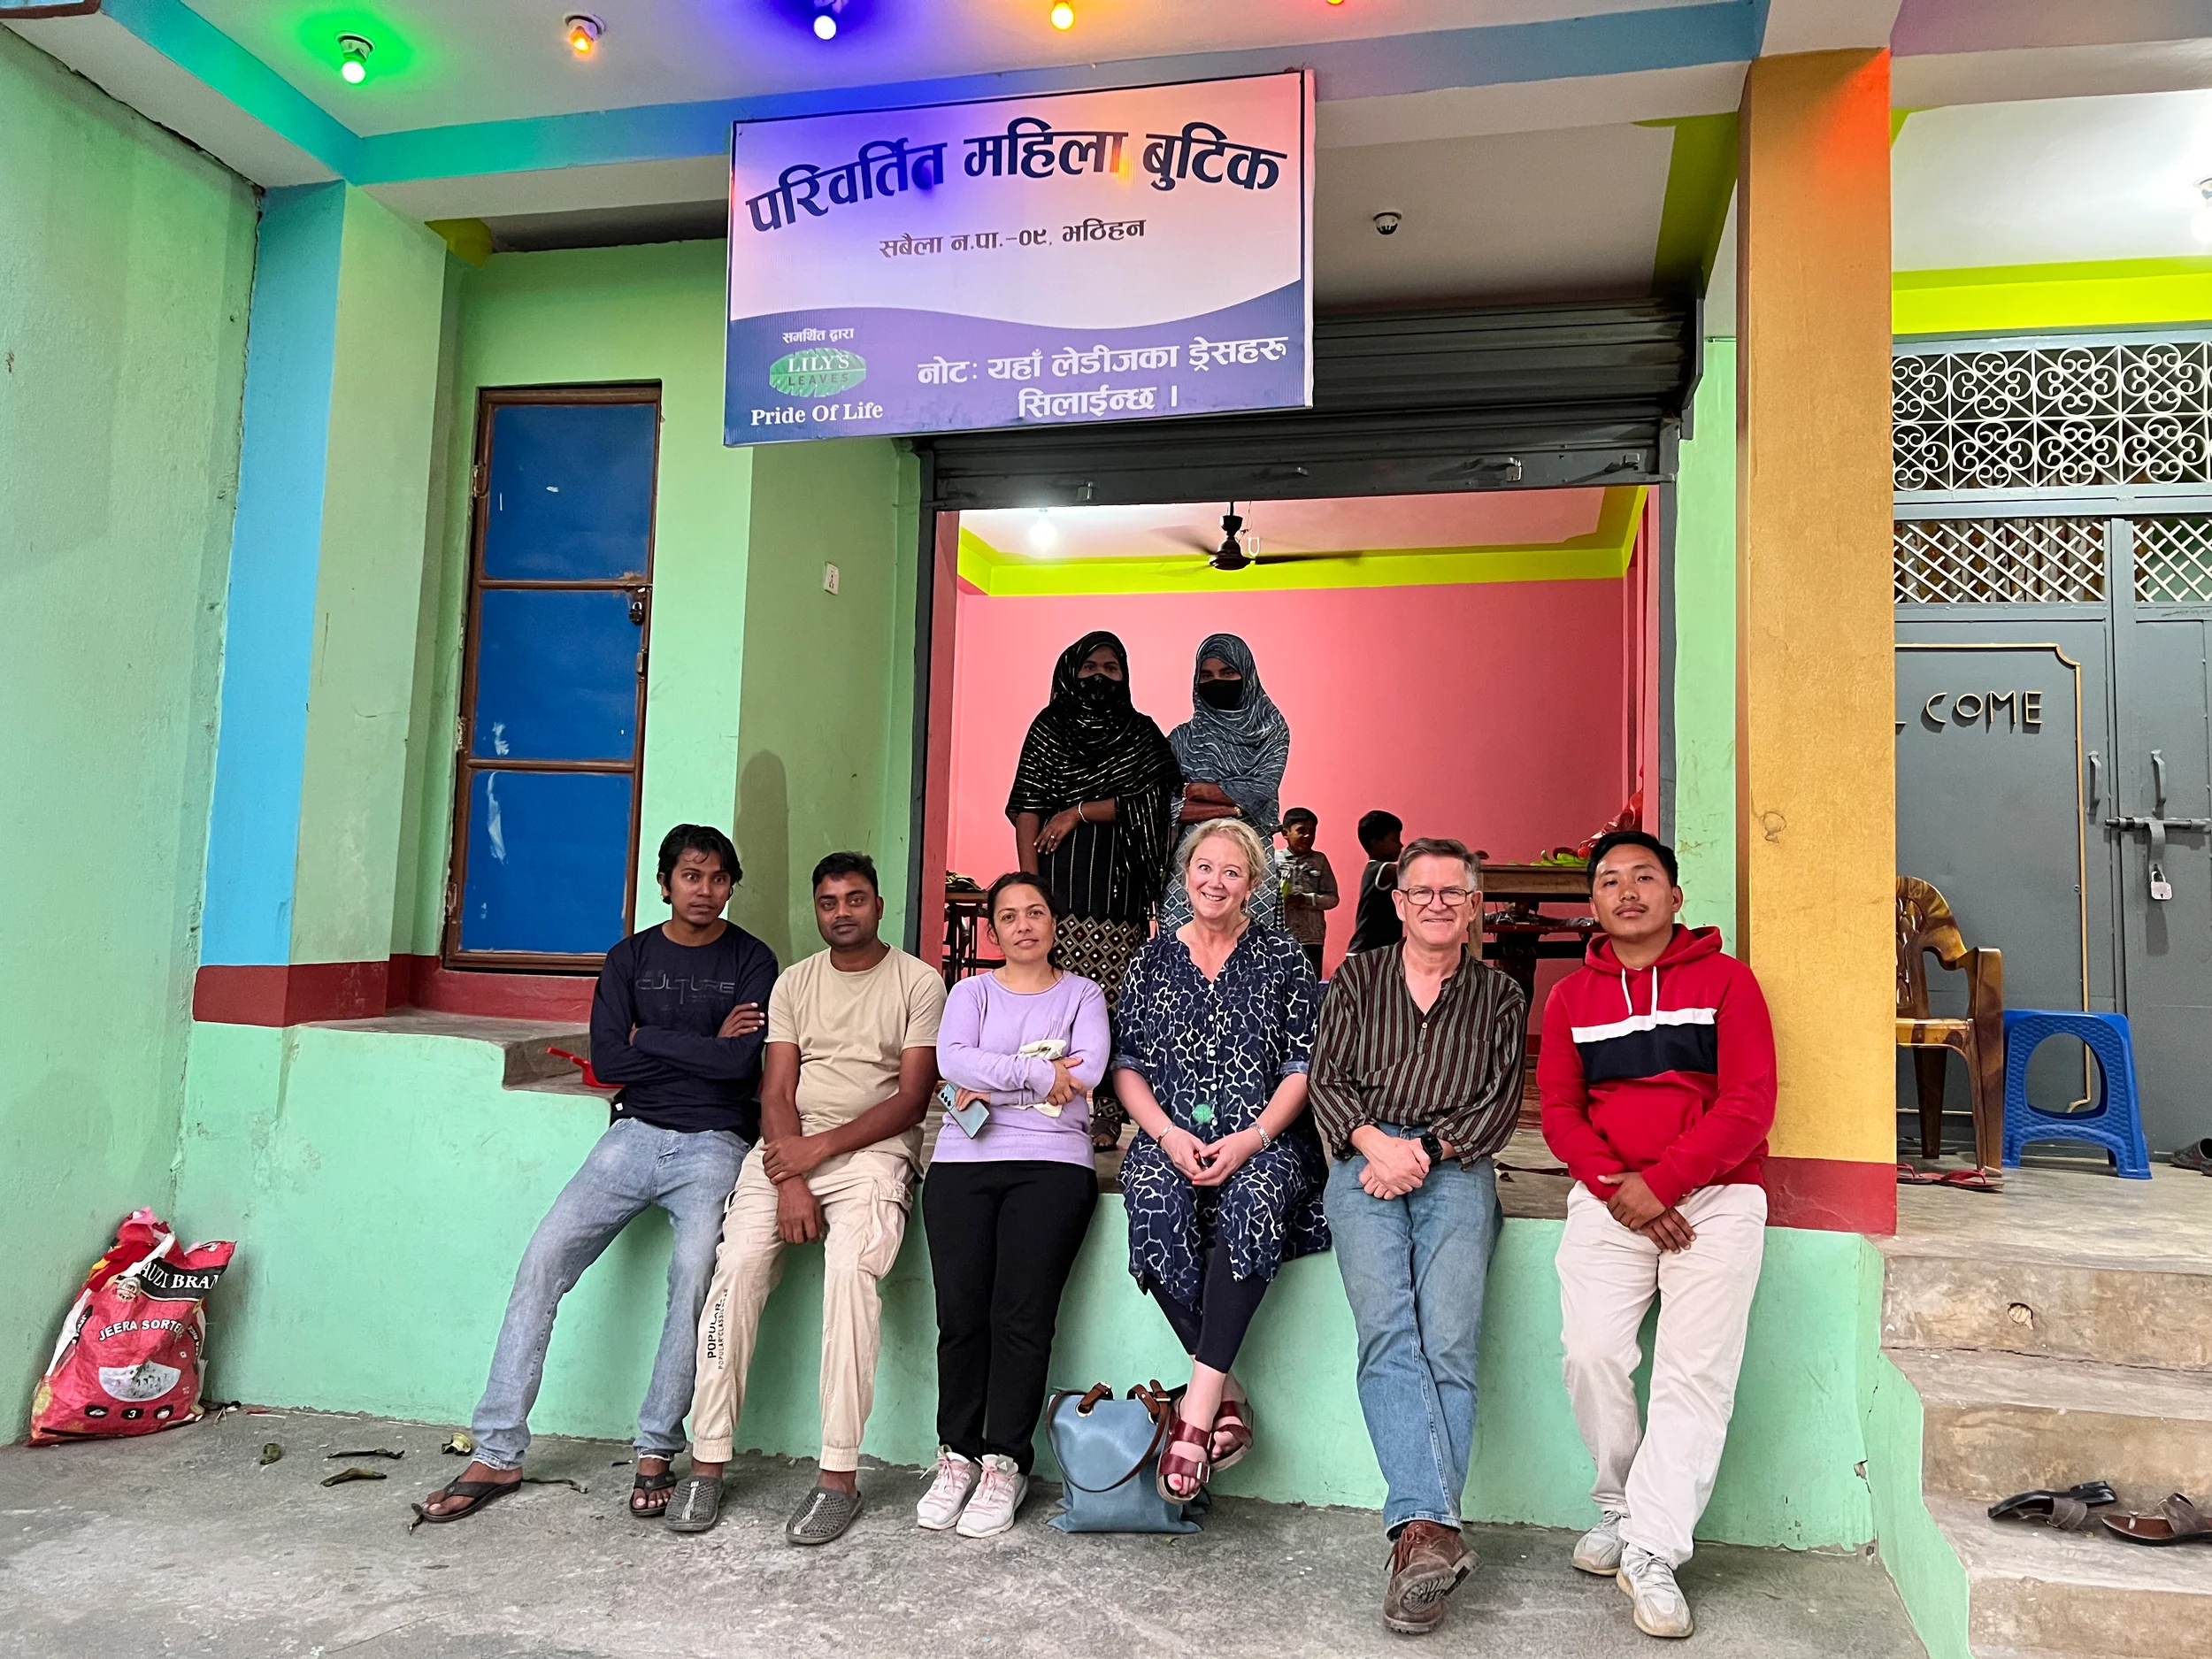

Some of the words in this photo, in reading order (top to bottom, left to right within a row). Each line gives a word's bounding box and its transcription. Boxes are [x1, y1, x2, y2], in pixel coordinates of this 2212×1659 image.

[746, 137, 948, 232] परिवर्तित
[964, 117, 1128, 179] महिला
[1143, 122, 1287, 191] बुटिक
[879, 233, 943, 257] सबैला
[1063, 218, 1146, 242] भठिहन
[829, 328, 855, 342] द्वारा
[788, 354, 849, 373] LILY'S
[987, 348, 1043, 380] यहाँ
[1051, 344, 1180, 377] लेडीजका
[788, 373, 849, 387] LEAVES
[750, 407, 806, 426] Pride
[812, 404, 839, 422] Of
[843, 402, 883, 420] Life
[1895, 690, 2043, 725] COME
[635, 973, 735, 1004] CULTURE
[142, 1261, 169, 1288] AUZI
[98, 1320, 138, 1340] JEERA
[707, 1302, 721, 1359] POPULAR
